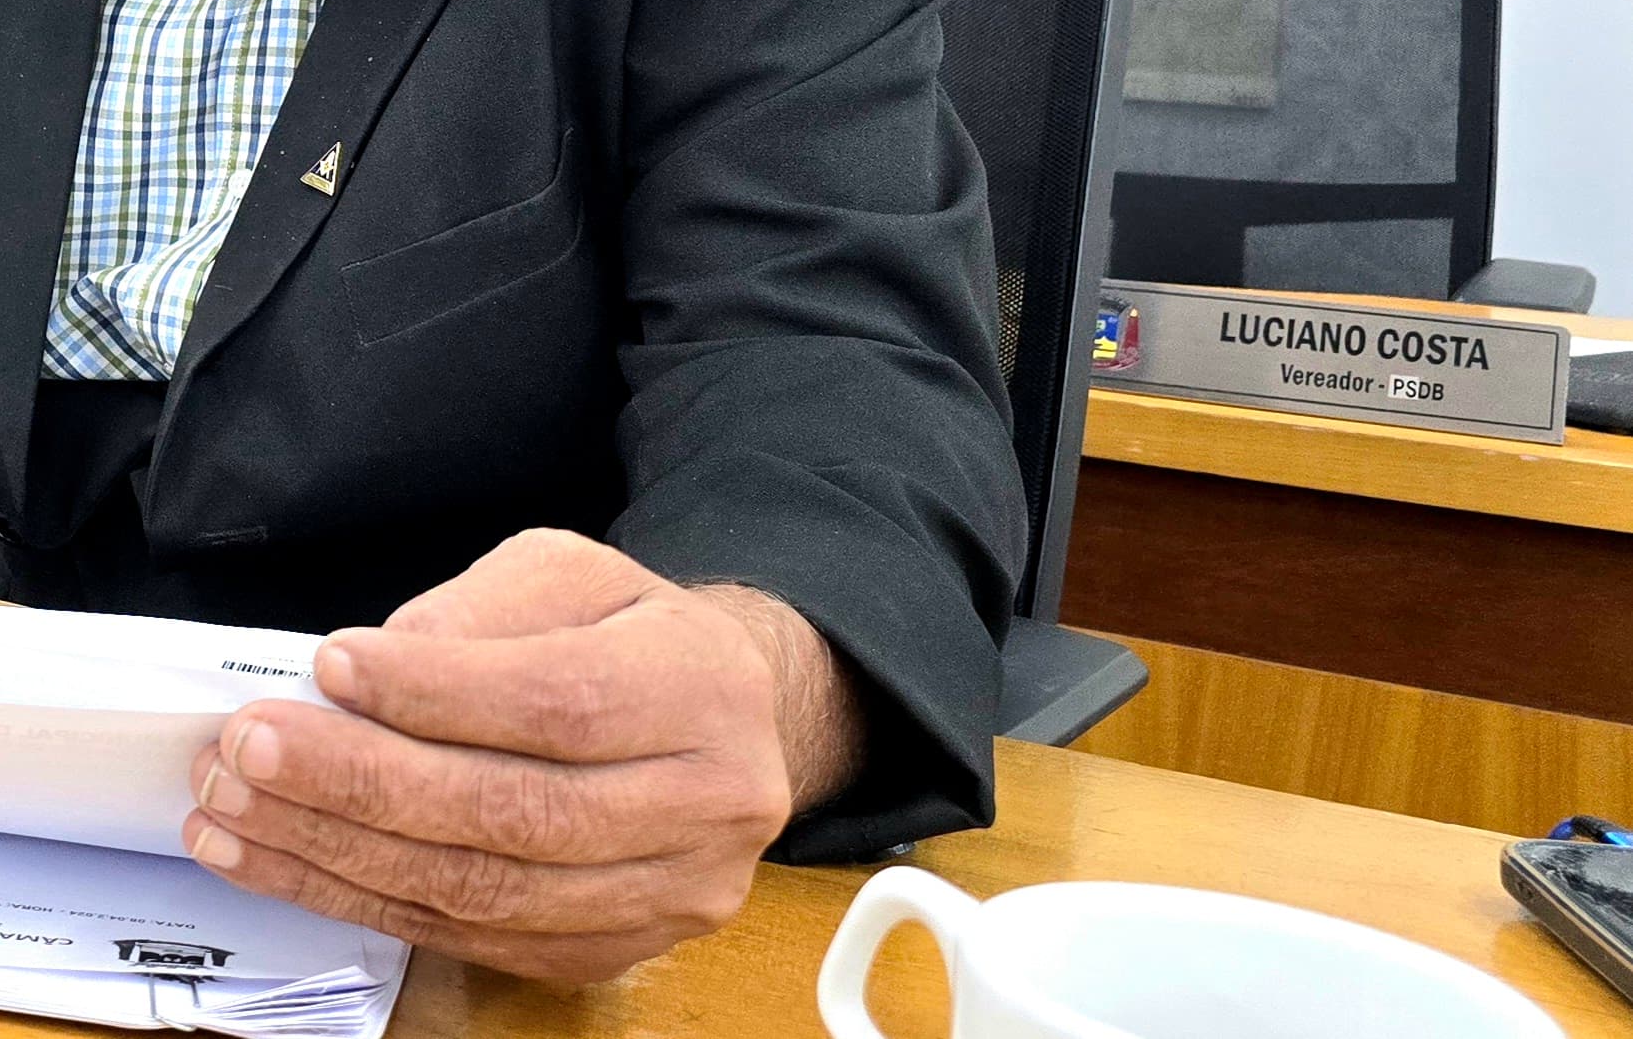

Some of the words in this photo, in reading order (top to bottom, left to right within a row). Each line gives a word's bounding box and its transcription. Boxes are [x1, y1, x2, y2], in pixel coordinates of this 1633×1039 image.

[1219, 312, 1366, 356] LUCIANO
[1377, 328, 1489, 370] COSTA
[1281, 363, 1374, 393] Vereador
[1392, 378, 1444, 401] PSDB
